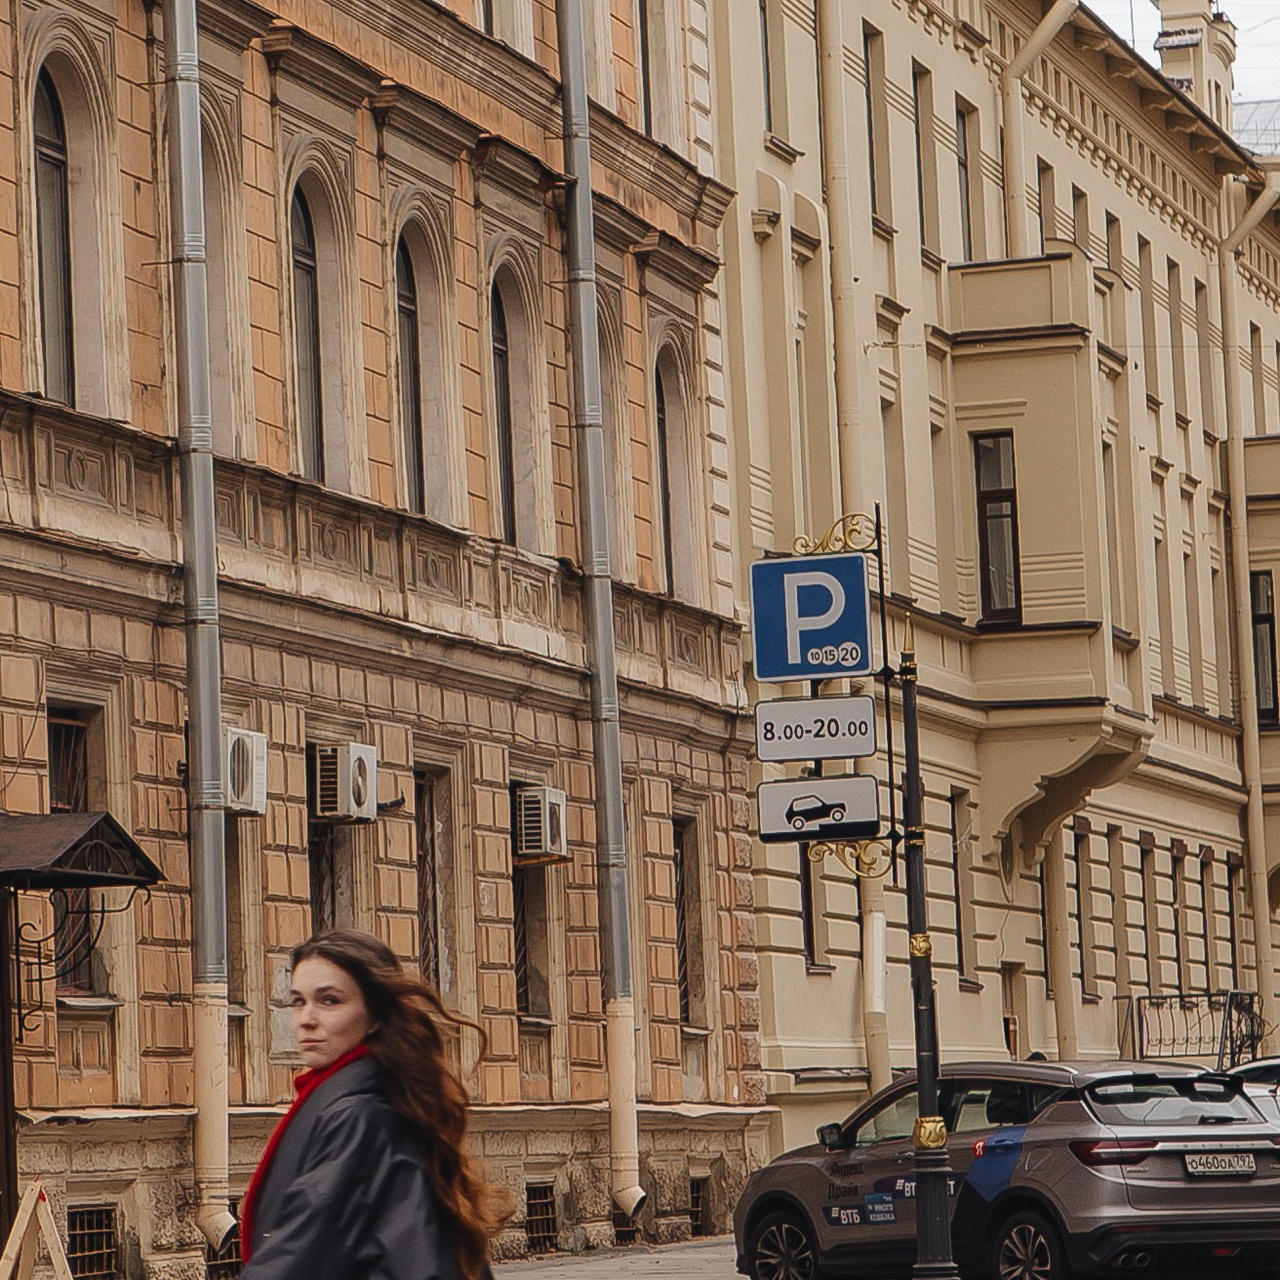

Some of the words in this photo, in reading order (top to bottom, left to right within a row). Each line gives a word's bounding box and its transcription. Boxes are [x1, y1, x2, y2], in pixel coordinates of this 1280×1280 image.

[783, 571, 846, 664] P
[810, 651, 820, 661] 10
[824, 649, 836, 662] 15
[840, 647, 859, 662] 20
[763, 718, 869, 741] 8.00-20.00
[830, 1161, 865, 1178] Яндекс
[840, 1209, 861, 1224] ВТБ
